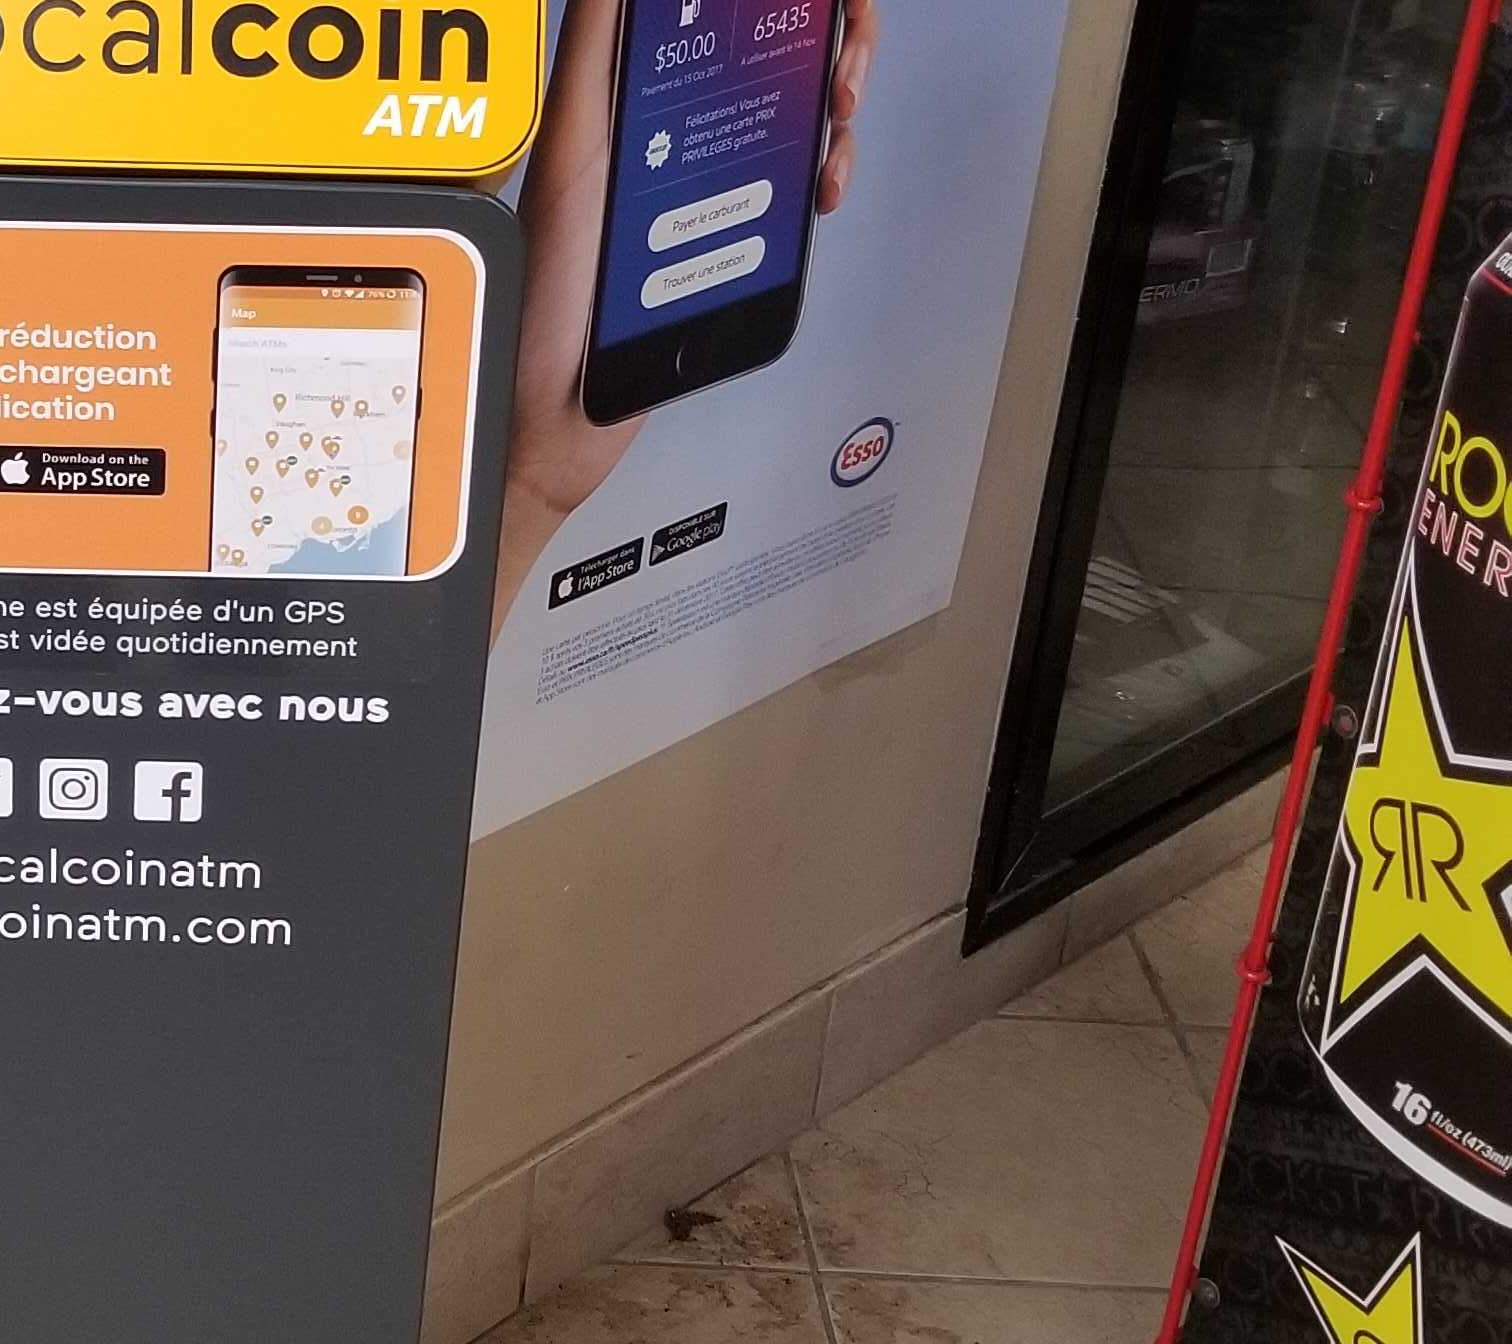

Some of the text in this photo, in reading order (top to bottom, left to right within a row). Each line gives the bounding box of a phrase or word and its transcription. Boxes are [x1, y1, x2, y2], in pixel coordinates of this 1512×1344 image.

[754, 3, 811, 41] 65435
[655, 31, 716, 74] $50.00
[361, 93, 489, 139] ATM
[672, 215, 699, 233] Payer
[663, 253, 746, 290] Trouver station
[231, 308, 257, 321] Map
[42, 453, 149, 466] Download on the
[41, 467, 151, 491] App Store
[666, 527, 703, 553] Google
[606, 559, 635, 580] Store
[35, 597, 78, 618] est
[88, 597, 203, 625] équipée
[213, 599, 275, 623] d'un
[285, 601, 346, 624] GPS
[29, 629, 106, 652] vidée
[116, 632, 358, 657] quotidiennement
[158, 691, 263, 720] avec
[279, 694, 390, 723] nous
[1392, 1080, 1432, 1126] 16
